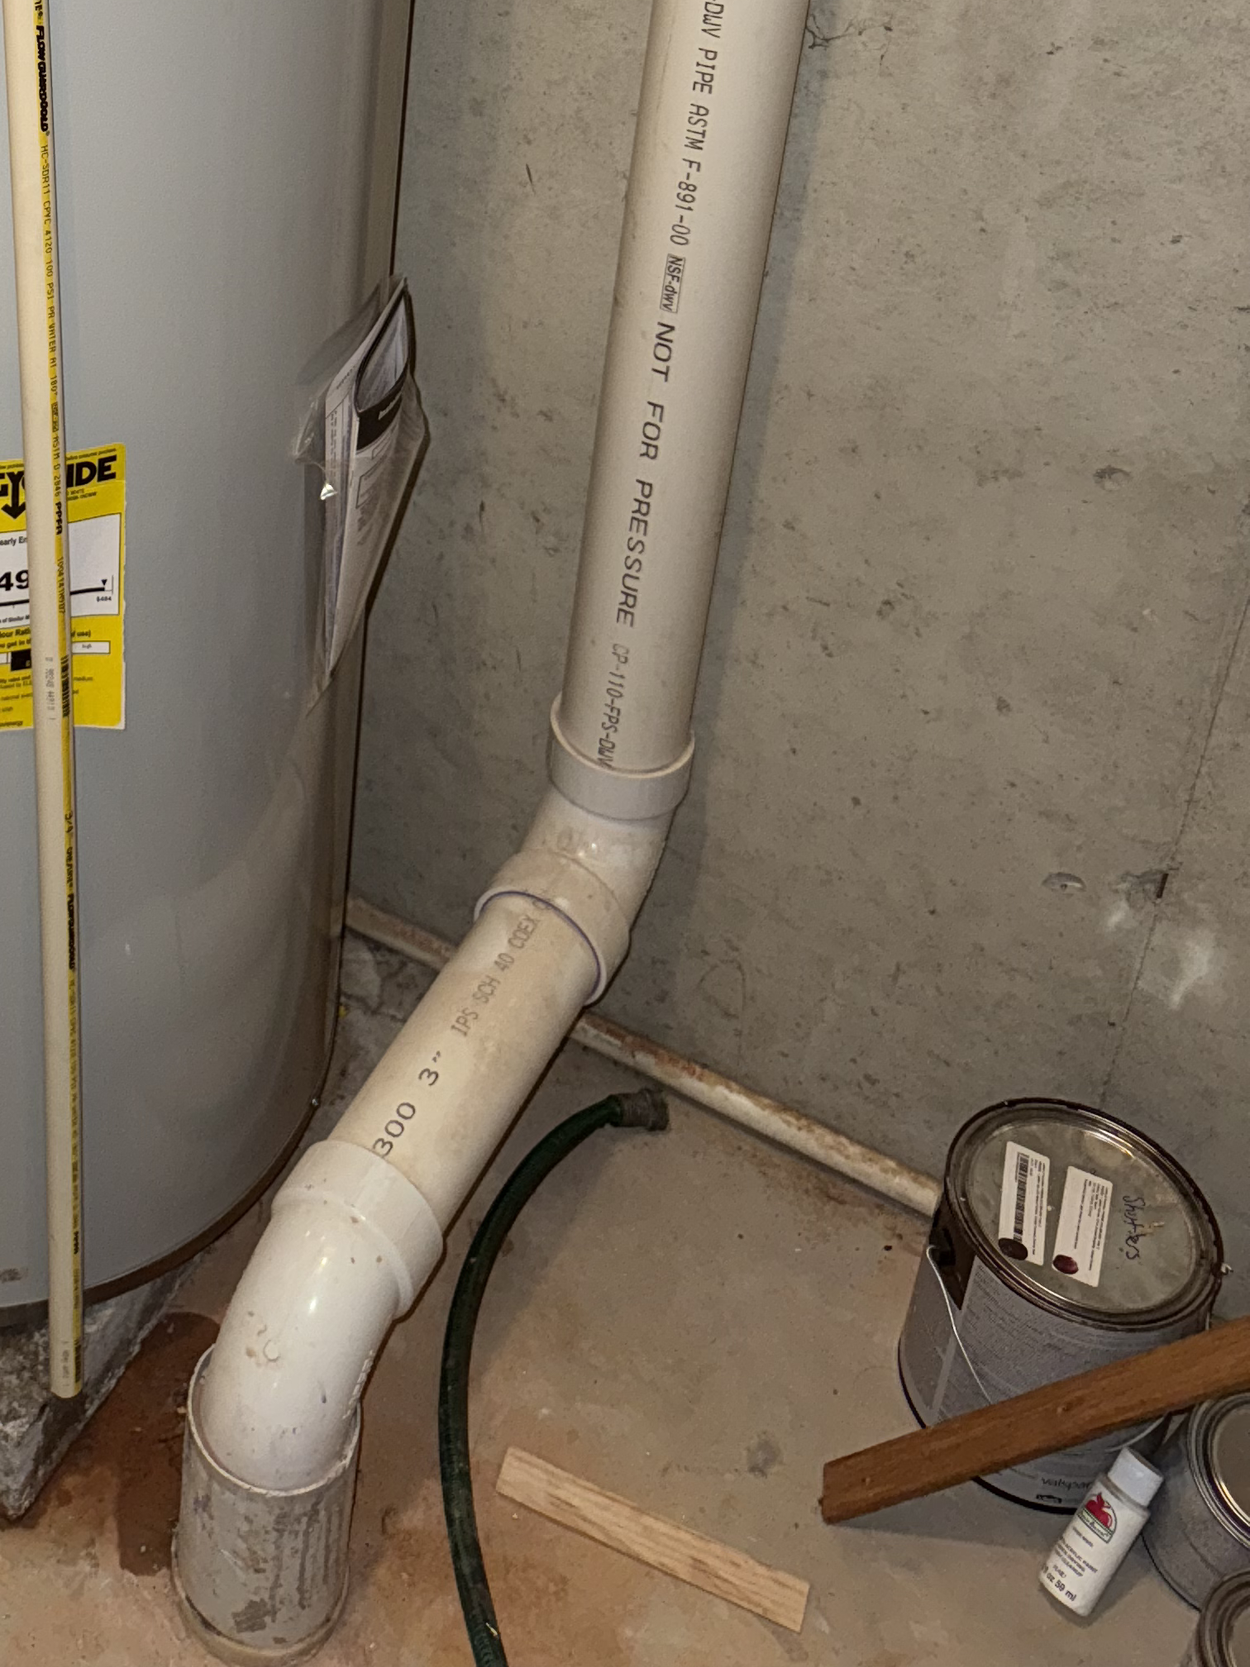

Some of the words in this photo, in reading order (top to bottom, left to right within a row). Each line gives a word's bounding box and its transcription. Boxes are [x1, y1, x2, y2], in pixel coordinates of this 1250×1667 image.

[693, 48, 718, 94] PIPE
[685, 103, 709, 151] ASTM
[670, 158, 701, 246] F-891-00
[651, 322, 676, 382] NOT
[639, 400, 665, 460] FOR
[616, 479, 653, 628] PRESSURE
[451, 1007, 479, 1037] IPS
[472, 975, 500, 1004] SCH
[494, 952, 515, 972] 40
